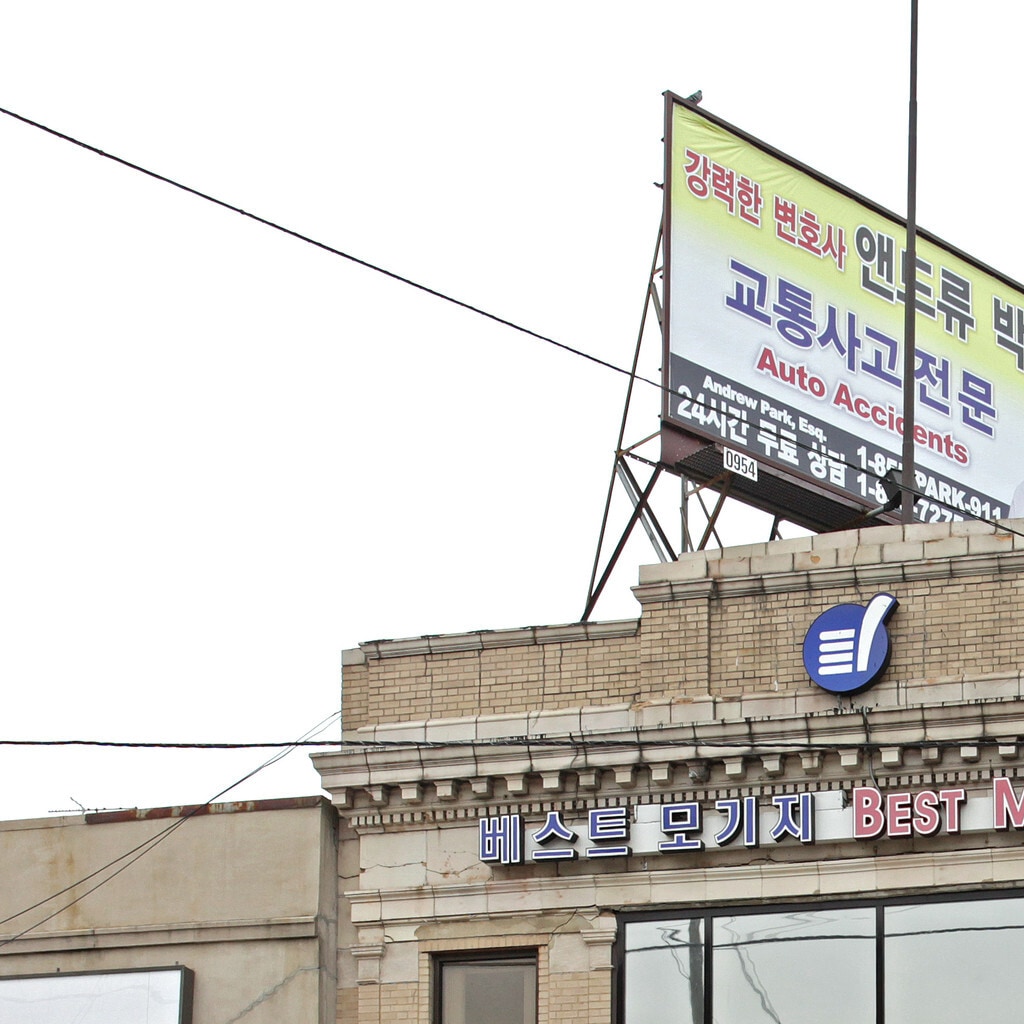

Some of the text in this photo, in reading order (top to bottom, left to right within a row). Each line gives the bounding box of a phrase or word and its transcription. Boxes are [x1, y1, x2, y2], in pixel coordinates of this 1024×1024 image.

[684, 148, 763, 227] 강력한
[773, 194, 847, 271] 변호사
[855, 224, 976, 343] 앤드류
[756, 346, 826, 398] Auto
[677, 385, 848, 488] 24시간 무료 상담
[703, 375, 828, 443] Andrew Park, Esq.
[726, 449, 756, 478] 0954
[479, 792, 814, 865] 베스트 모기지
[853, 786, 965, 839] BEST
